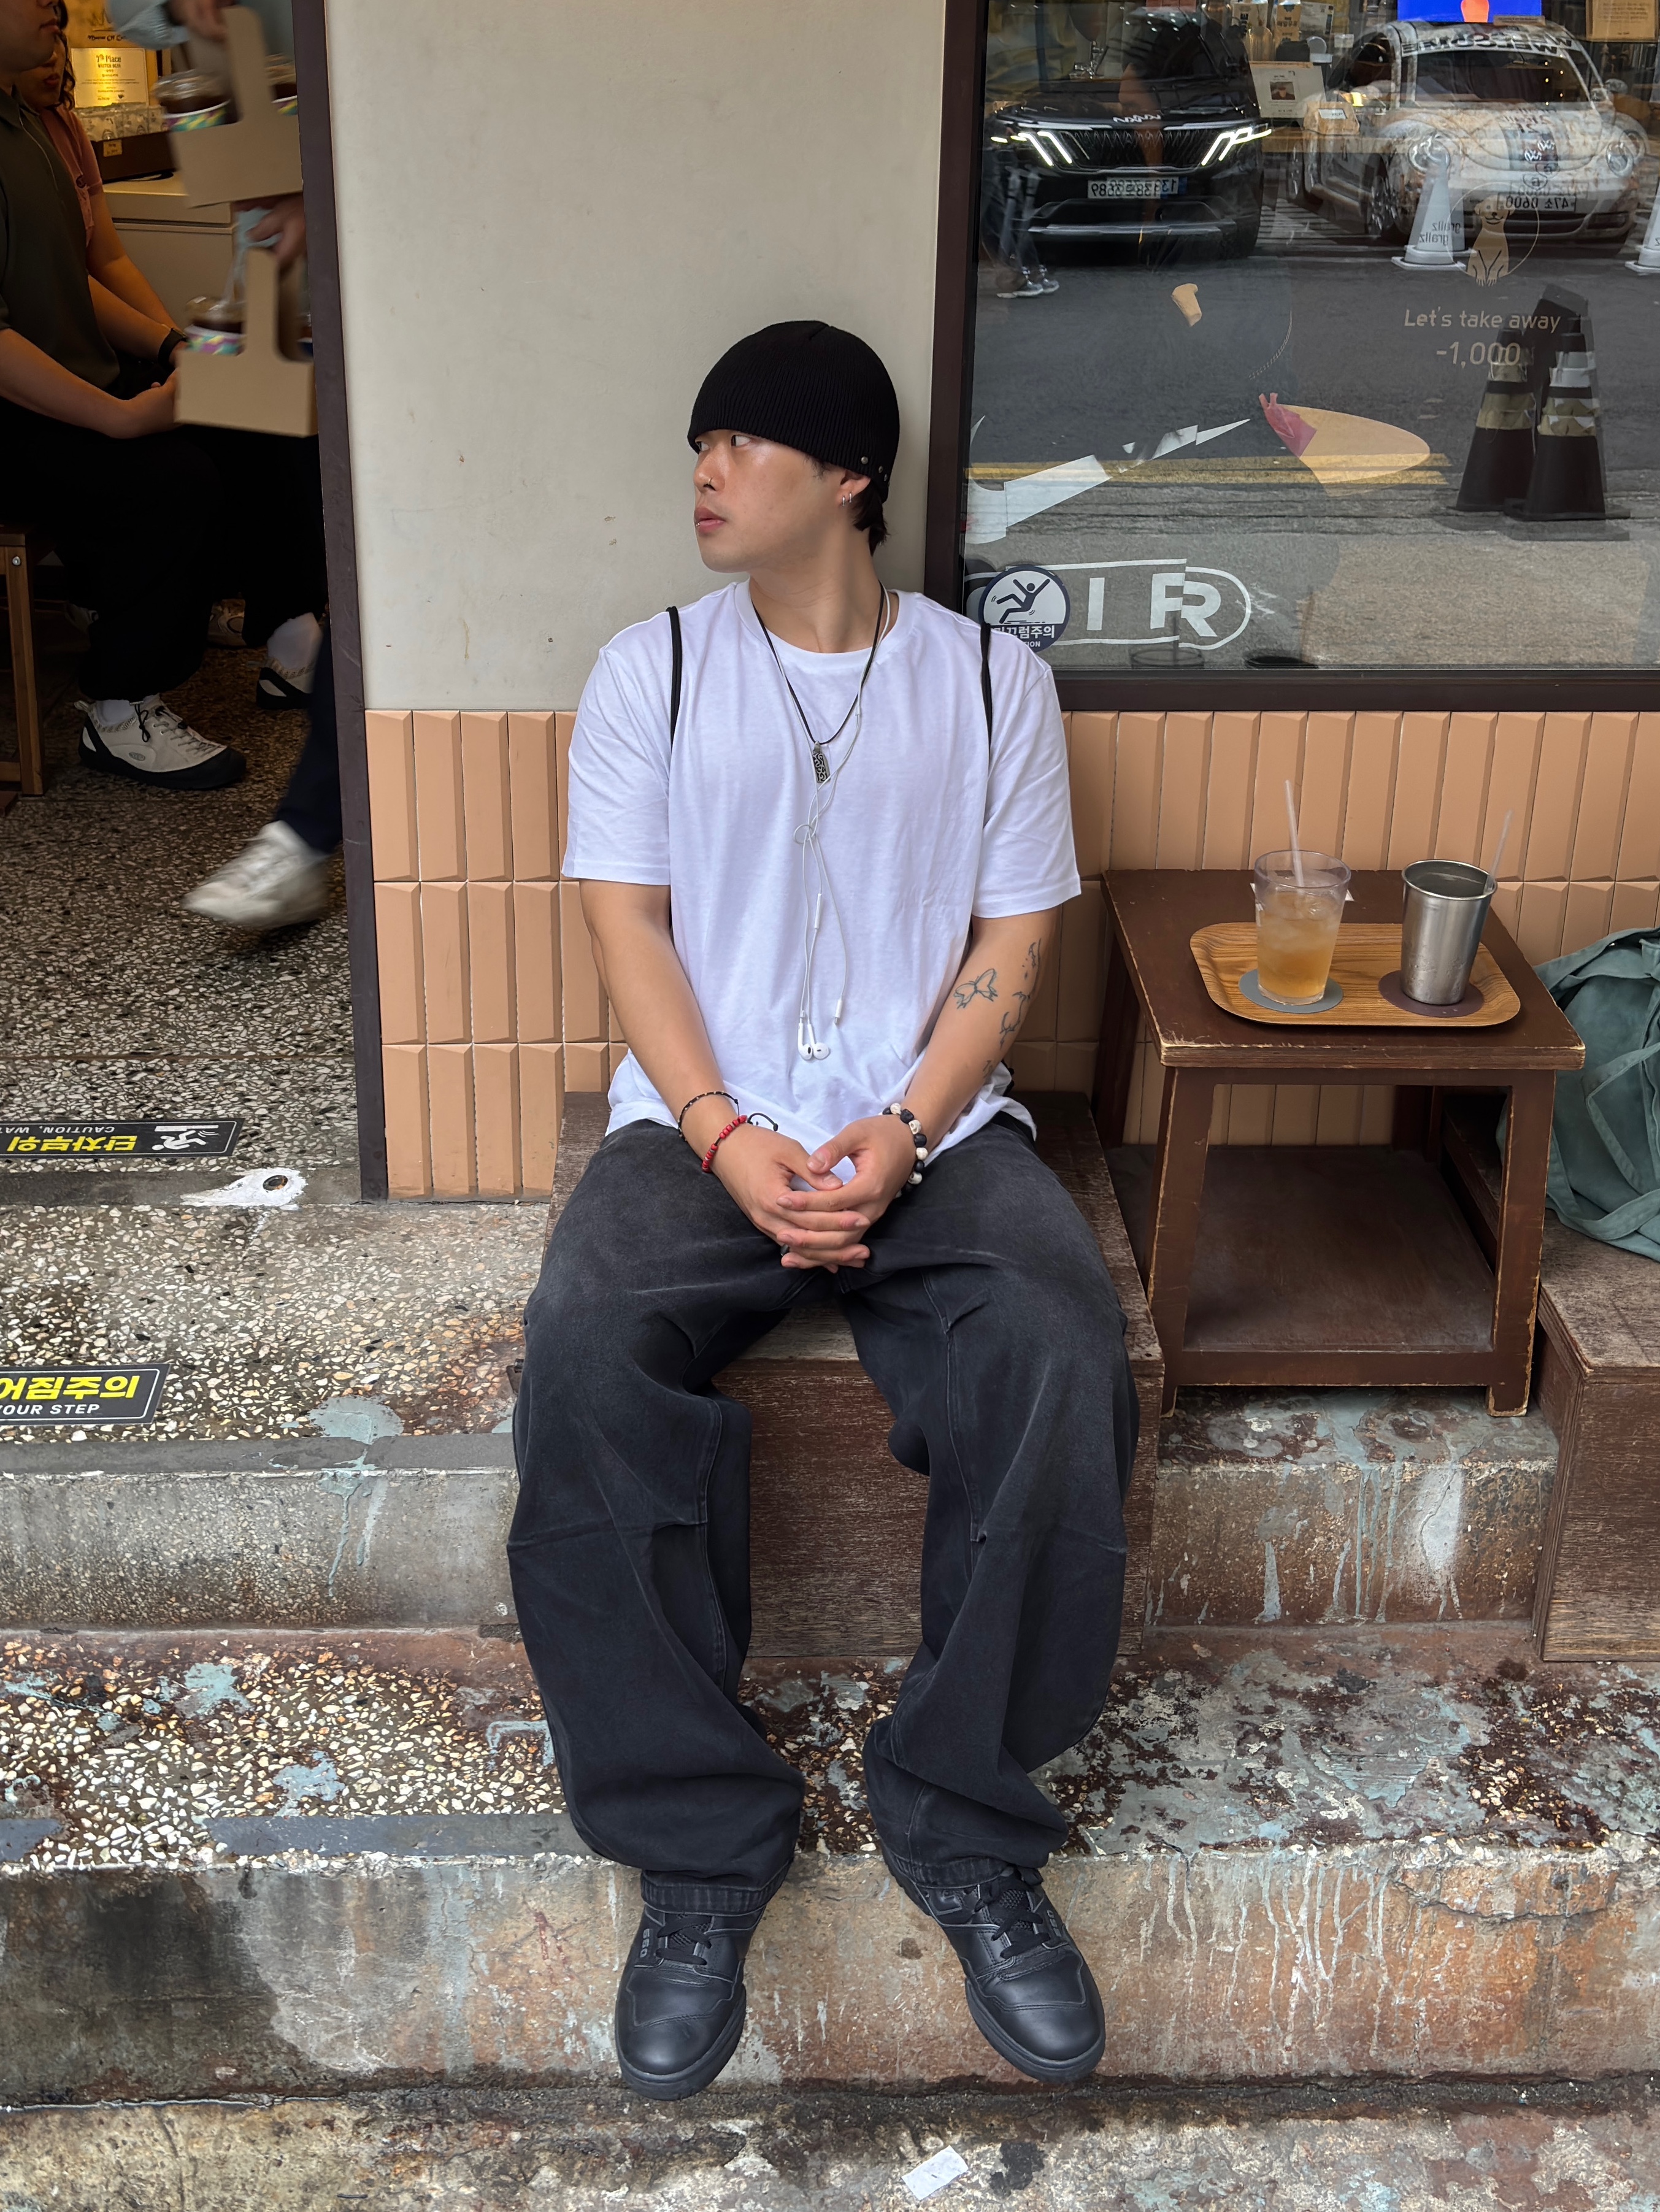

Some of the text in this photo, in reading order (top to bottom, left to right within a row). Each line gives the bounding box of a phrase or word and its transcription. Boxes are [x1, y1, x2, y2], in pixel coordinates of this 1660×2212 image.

[1404, 306, 1561, 333] Let's take away
[1436, 341, 1521, 368] -1,000
[39, 1125, 115, 1134] CAUTION,
[7, 1135, 137, 1151] 단차부위
[50, 1404, 100, 1415] STEP
